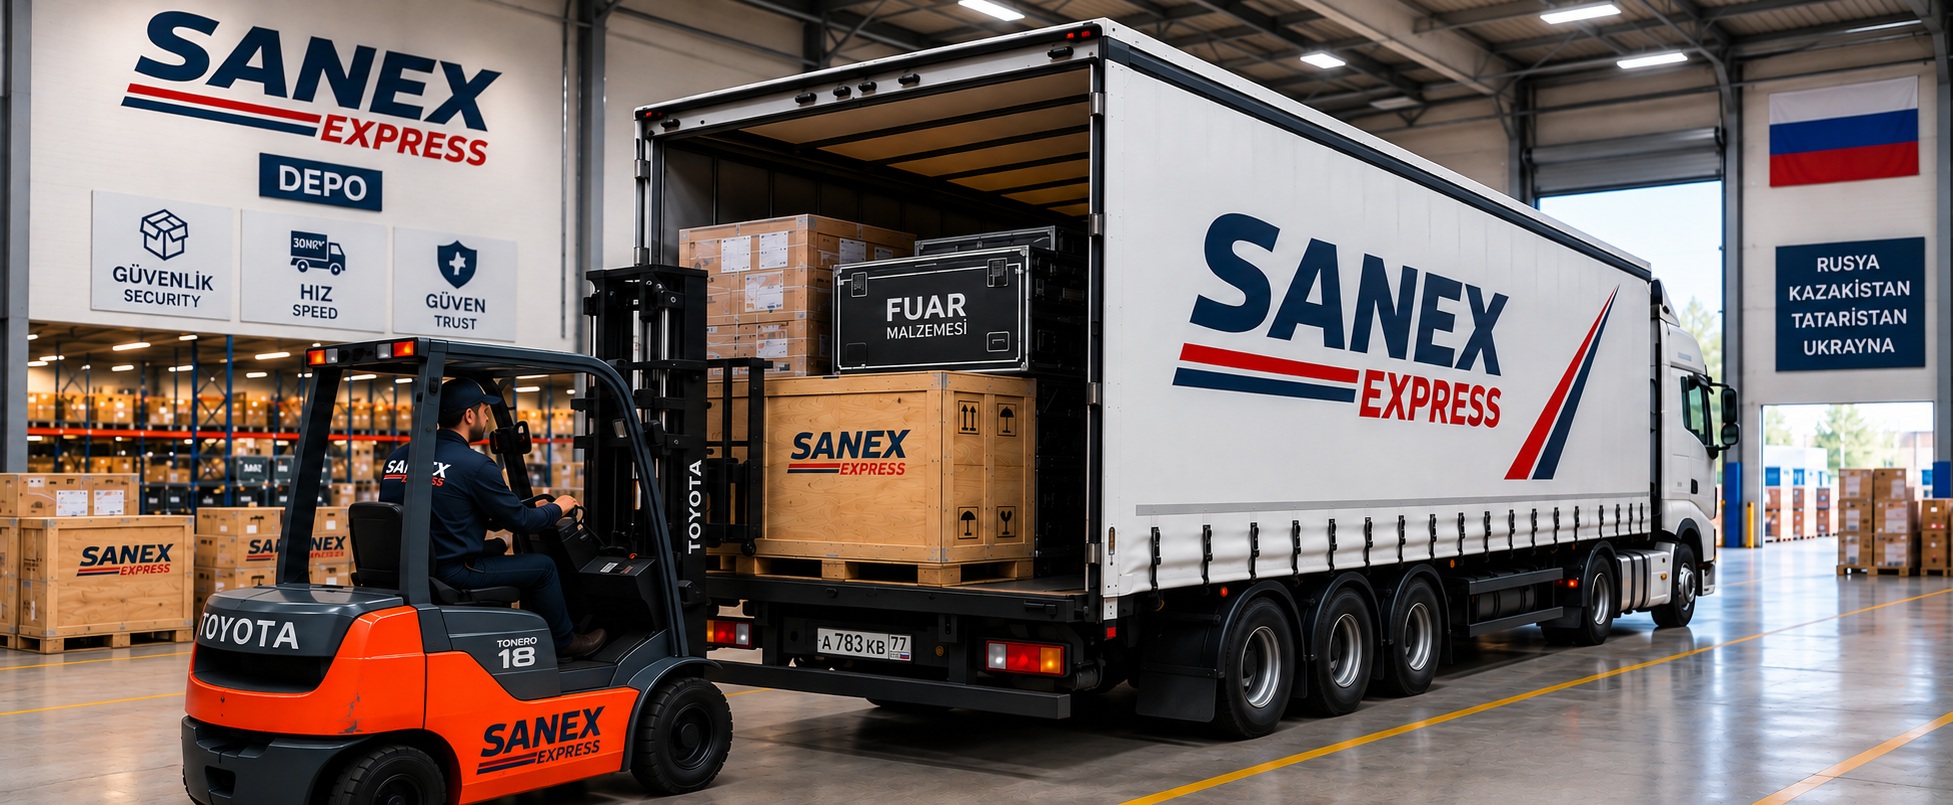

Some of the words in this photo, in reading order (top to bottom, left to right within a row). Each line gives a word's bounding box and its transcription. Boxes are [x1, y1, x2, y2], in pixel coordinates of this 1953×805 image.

[134, 10, 502, 132] SANEX
[320, 114, 489, 167] EXPRESS
[279, 164, 367, 202] DEPO
[1816, 254, 1880, 272] RUSYA
[112, 264, 214, 292] GÜVENLİK
[124, 288, 201, 309] SECURITY
[300, 284, 333, 303] HIZ
[1189, 212, 1510, 376] SANEX
[1788, 279, 1910, 301] KAZAKİSTAN
[293, 304, 338, 321] SPEED
[425, 291, 486, 314] GÜVEN
[886, 293, 967, 322] FUAR
[434, 314, 477, 330] TRUST
[1791, 307, 1907, 328] TATARİSTAN
[886, 319, 967, 340] MALZEMESİ
[1803, 336, 1895, 355] UKRAYNA
[1359, 369, 1502, 428] EXPRESS
[790, 429, 911, 460] SANEX
[386, 460, 451, 478] SAX
[839, 462, 906, 476] EXPRESS
[688, 460, 702, 554] TOYOTA
[80, 543, 174, 566] SANEX
[120, 564, 171, 576] EXPRESS
[200, 612, 299, 649] TOYOTA
[496, 636, 538, 648] TONERO
[835, 632, 863, 653] 783
[891, 636, 907, 651] 77
[498, 646, 536, 669] 18
[480, 705, 605, 757] SANEX
[536, 739, 600, 764] EXPRESS
